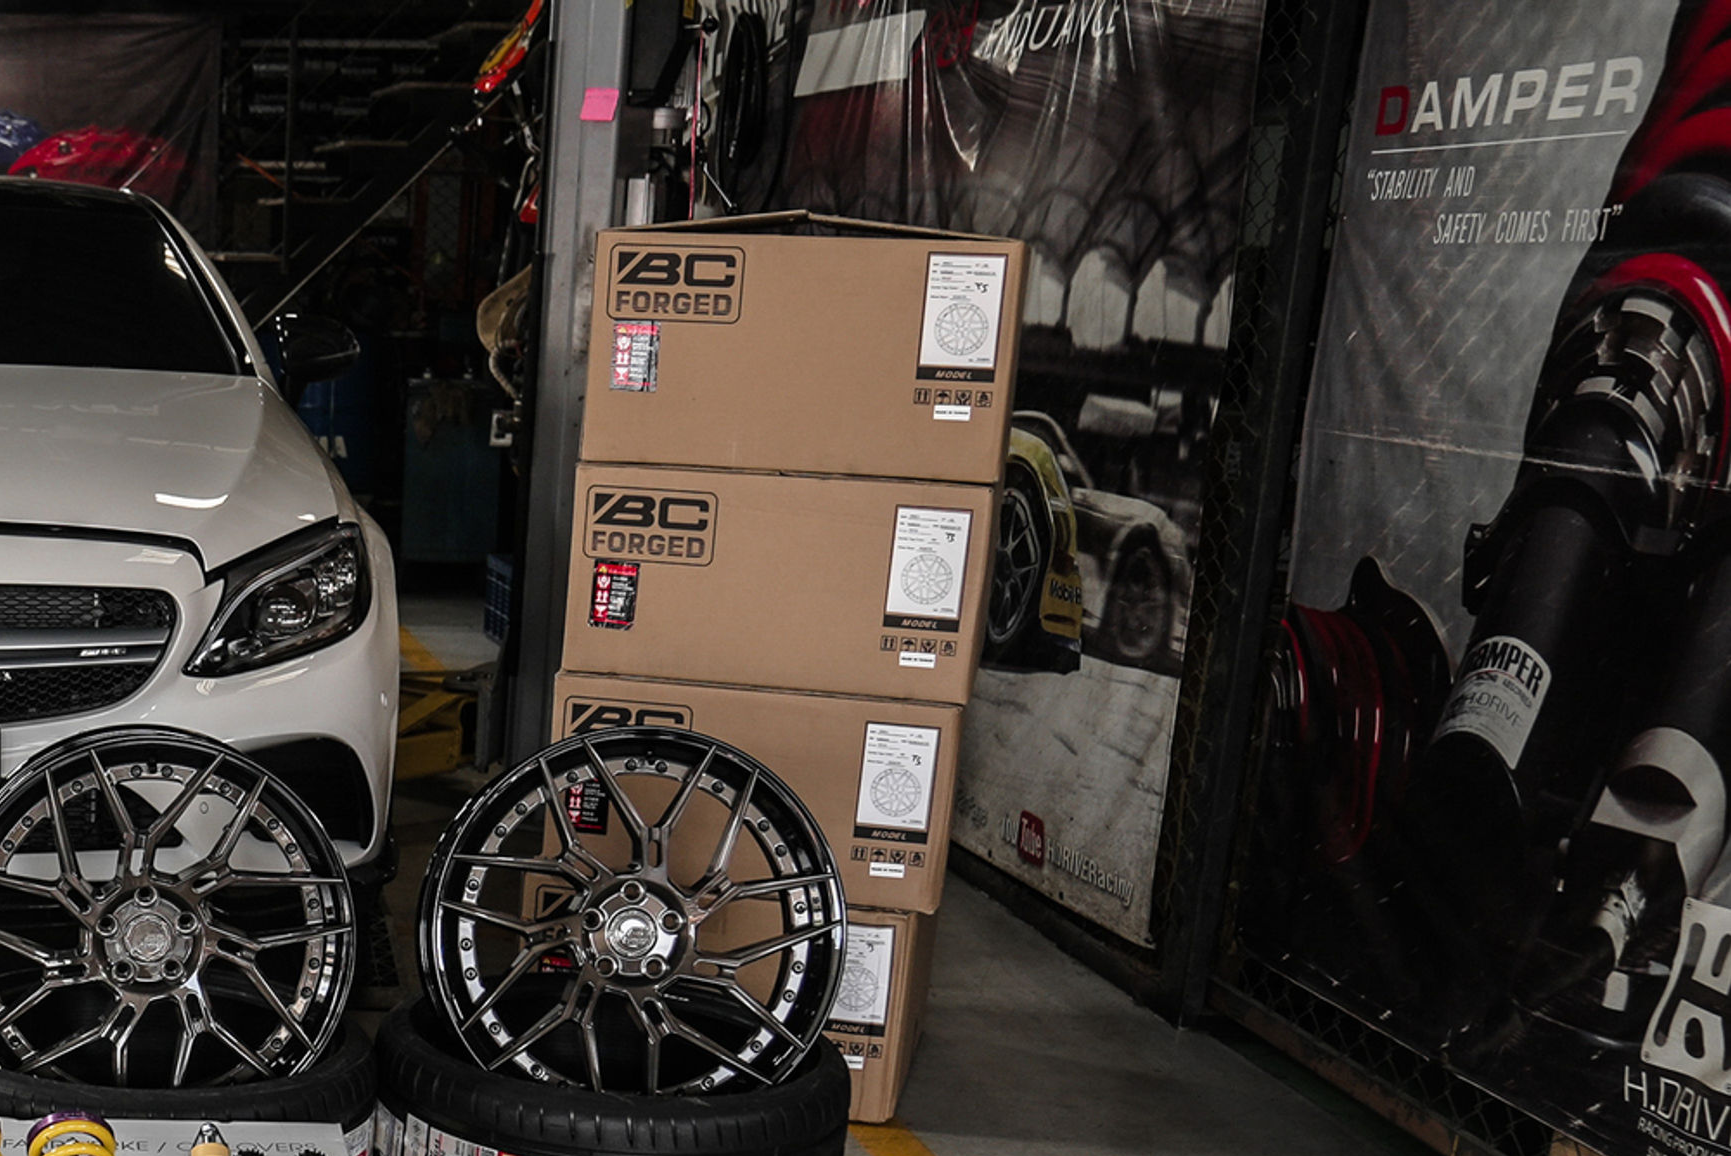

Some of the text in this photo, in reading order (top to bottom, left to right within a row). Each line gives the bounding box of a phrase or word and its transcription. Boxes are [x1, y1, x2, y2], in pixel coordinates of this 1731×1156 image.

[1375, 56, 1643, 136] DAMPER
[1443, 165, 1475, 198] AND
[1433, 212, 1487, 245] SAFETY
[1495, 210, 1550, 243] COMES
[617, 251, 737, 288] BC
[615, 290, 733, 316] FORGED
[935, 370, 972, 380] MODEL
[593, 493, 710, 531] BC
[592, 530, 706, 559] FORGED
[901, 618, 938, 630] MODEL
[1470, 640, 1544, 698] AMPER
[872, 830, 907, 841] MODEL
[1624, 1065, 1731, 1148] H.DRIV
